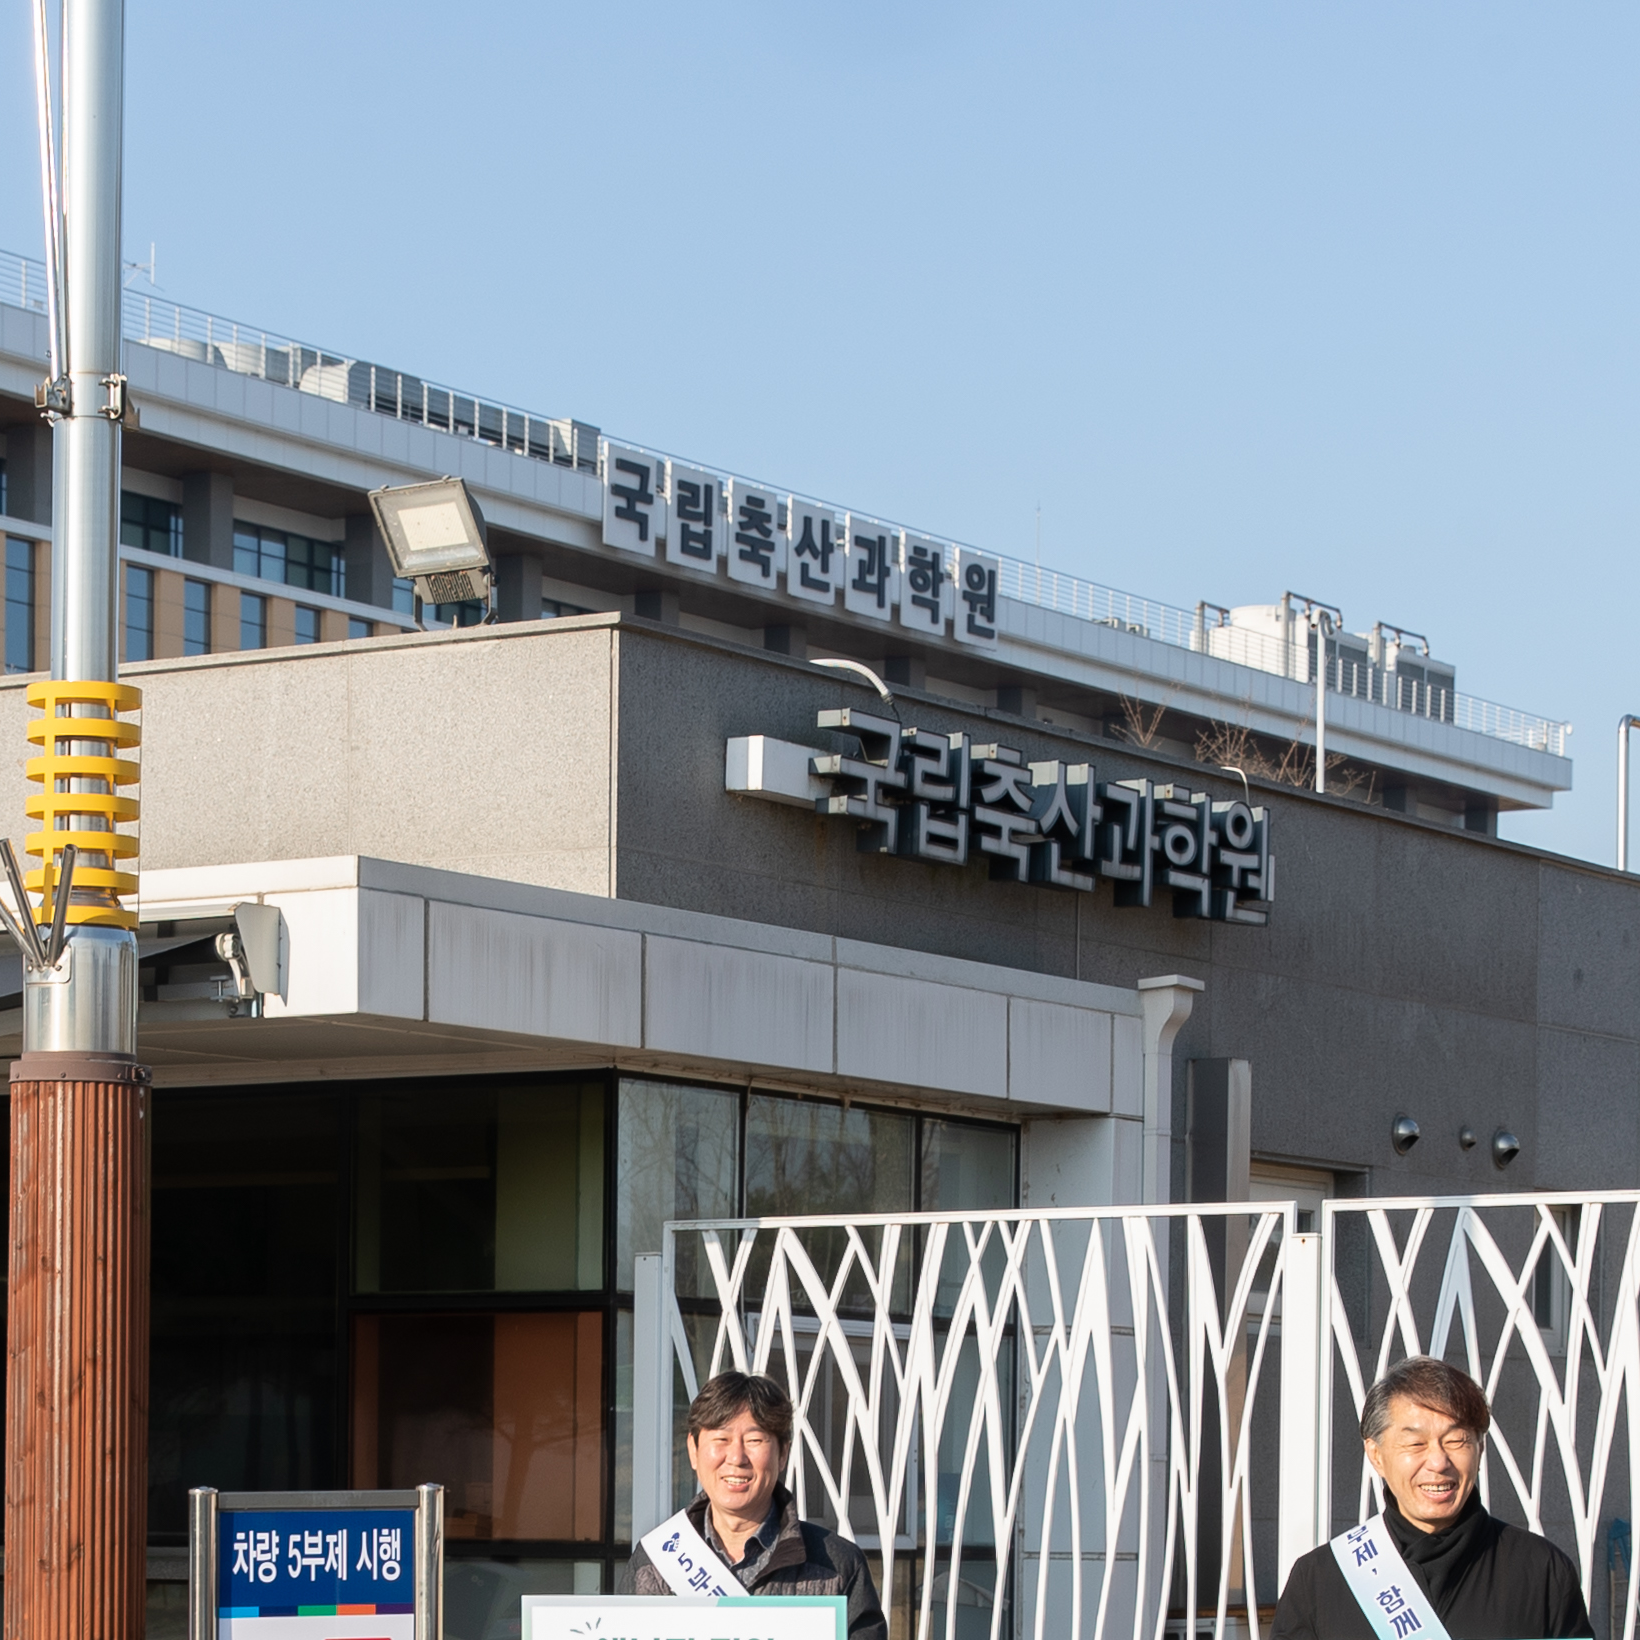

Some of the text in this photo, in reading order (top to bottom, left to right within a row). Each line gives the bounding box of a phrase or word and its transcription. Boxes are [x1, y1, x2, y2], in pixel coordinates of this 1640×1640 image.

[610, 456, 997, 641] 국립축산과학원
[809, 708, 1275, 926] 국립축산과학원
[232, 1528, 402, 1583] 차량 5부제 시행
[1376, 1585, 1423, 1639] 함께
